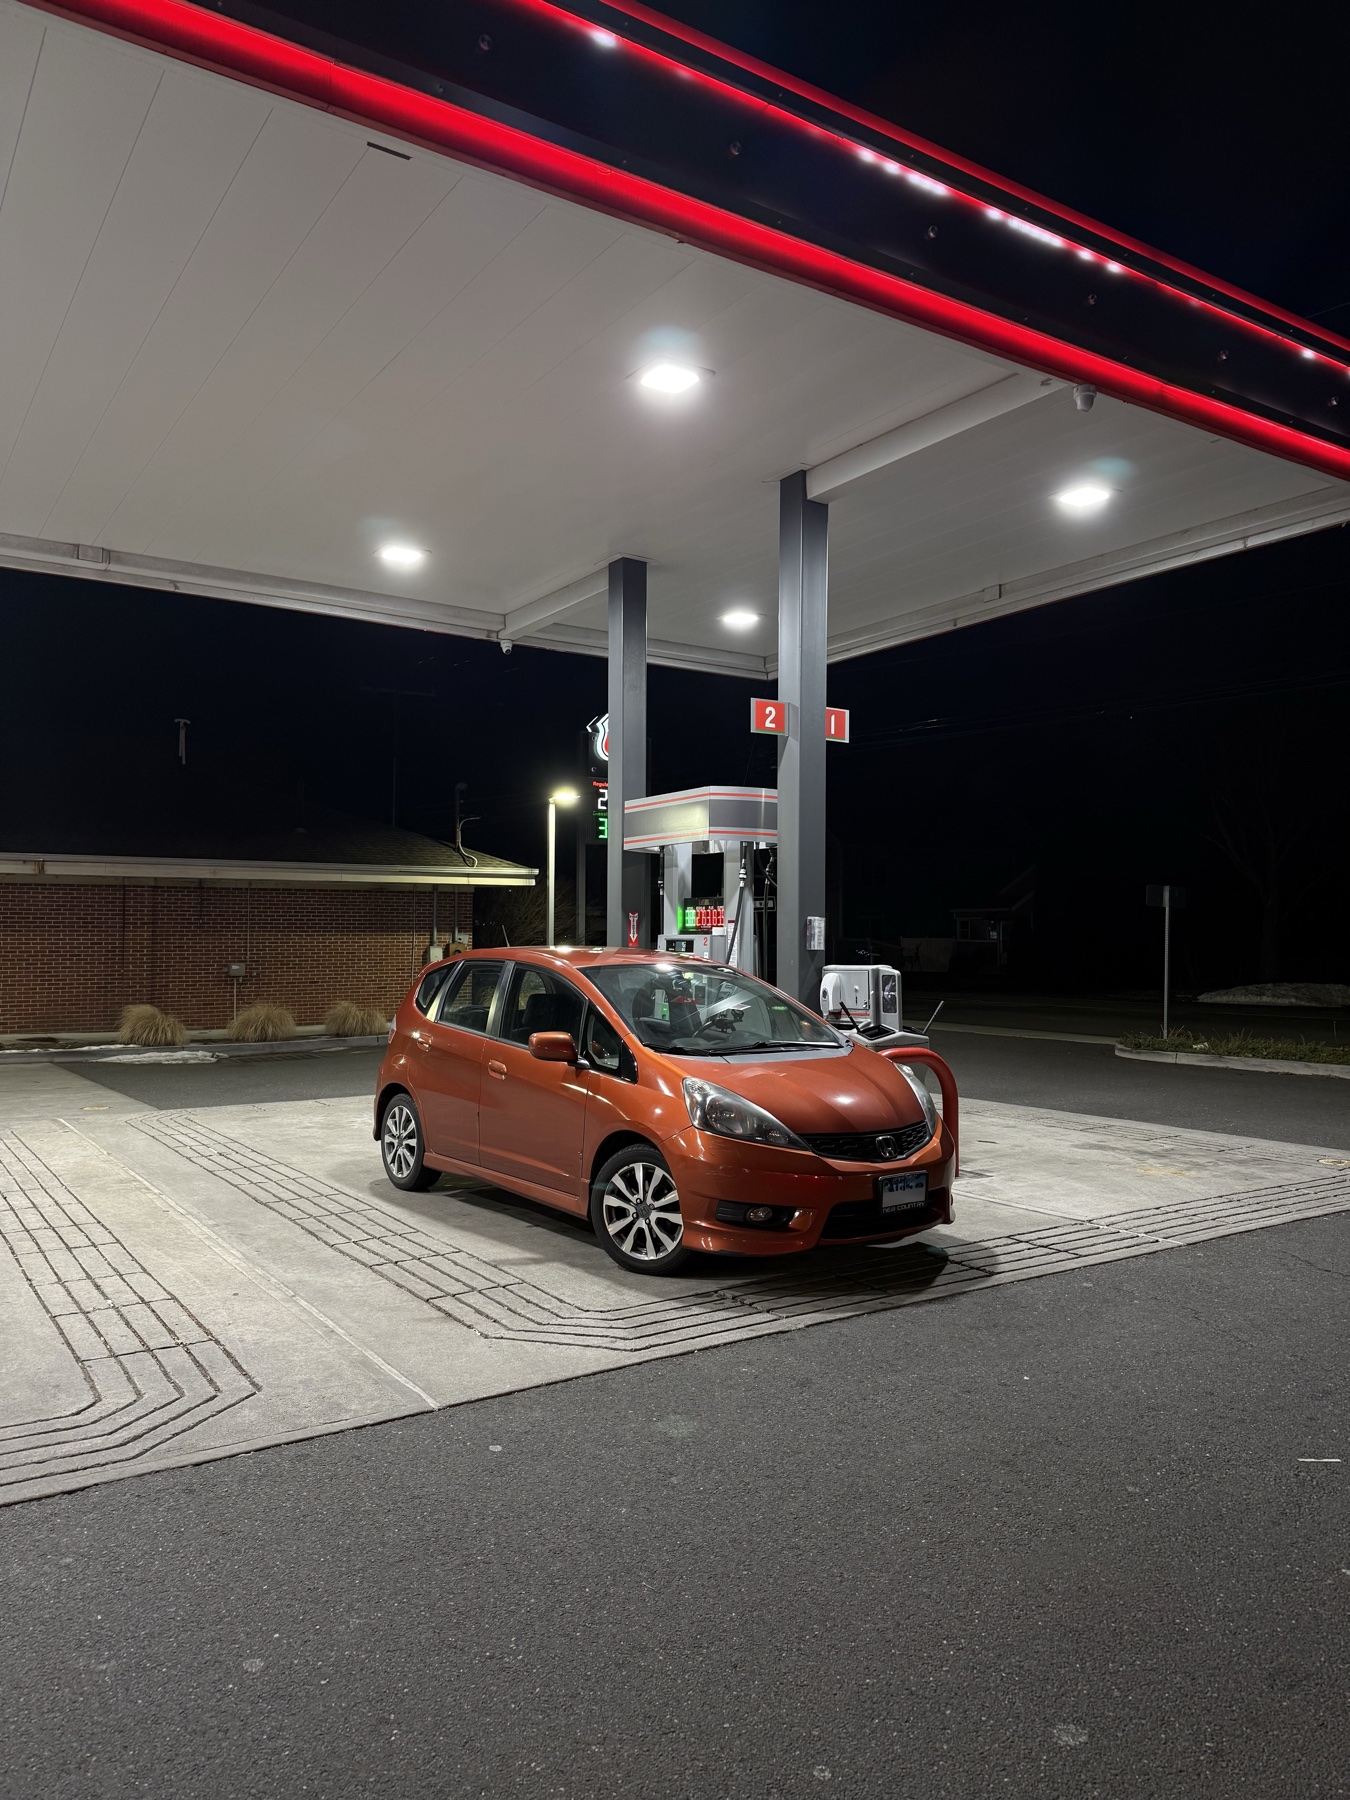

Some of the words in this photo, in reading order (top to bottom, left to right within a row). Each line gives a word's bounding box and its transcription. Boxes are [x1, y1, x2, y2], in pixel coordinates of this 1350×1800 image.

[764, 706, 776, 728] 2
[830, 714, 835, 735] 1
[703, 937, 708, 947] 2
[896, 1201, 926, 1211] COUNTRY
